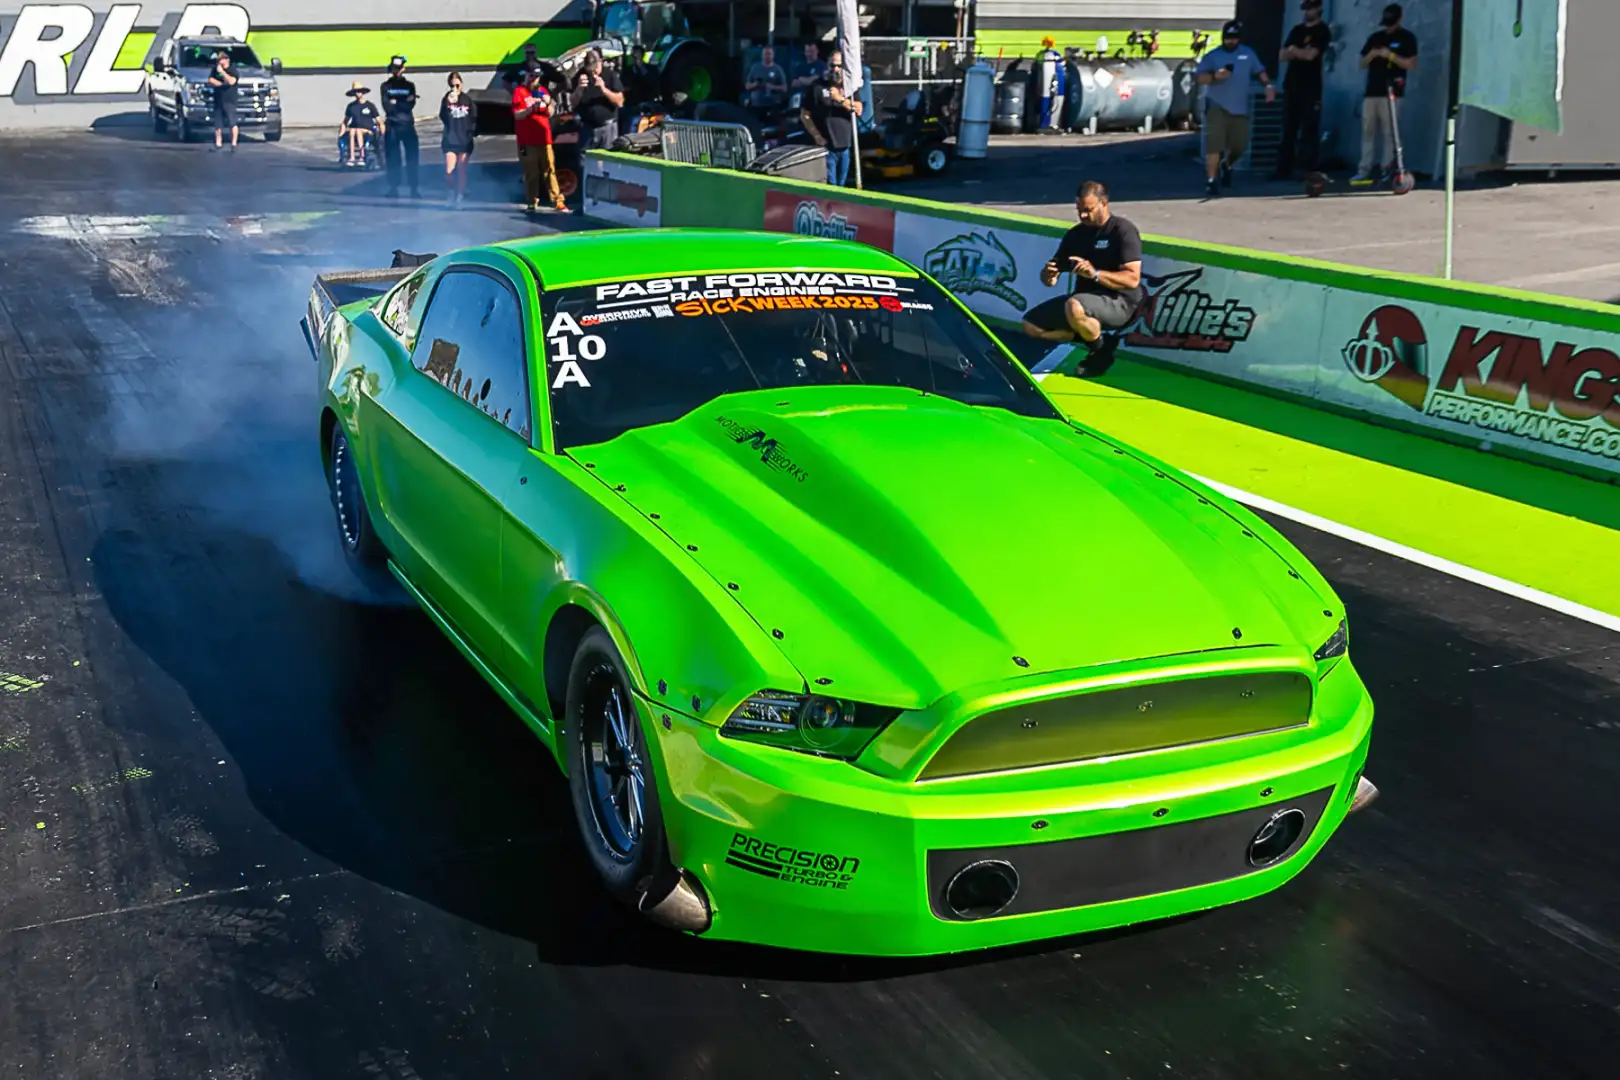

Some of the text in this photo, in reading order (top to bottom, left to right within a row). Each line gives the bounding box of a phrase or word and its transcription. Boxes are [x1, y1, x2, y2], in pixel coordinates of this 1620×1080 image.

[596, 273, 897, 301] FAST FORWARD
[670, 286, 835, 302] RACE ENGINES
[546, 311, 584, 337] A
[550, 335, 607, 361] 10
[552, 361, 592, 388] A
[730, 832, 861, 873] PRECISION
[780, 873, 849, 890] ENGINE
[783, 865, 837, 880] TURBO
